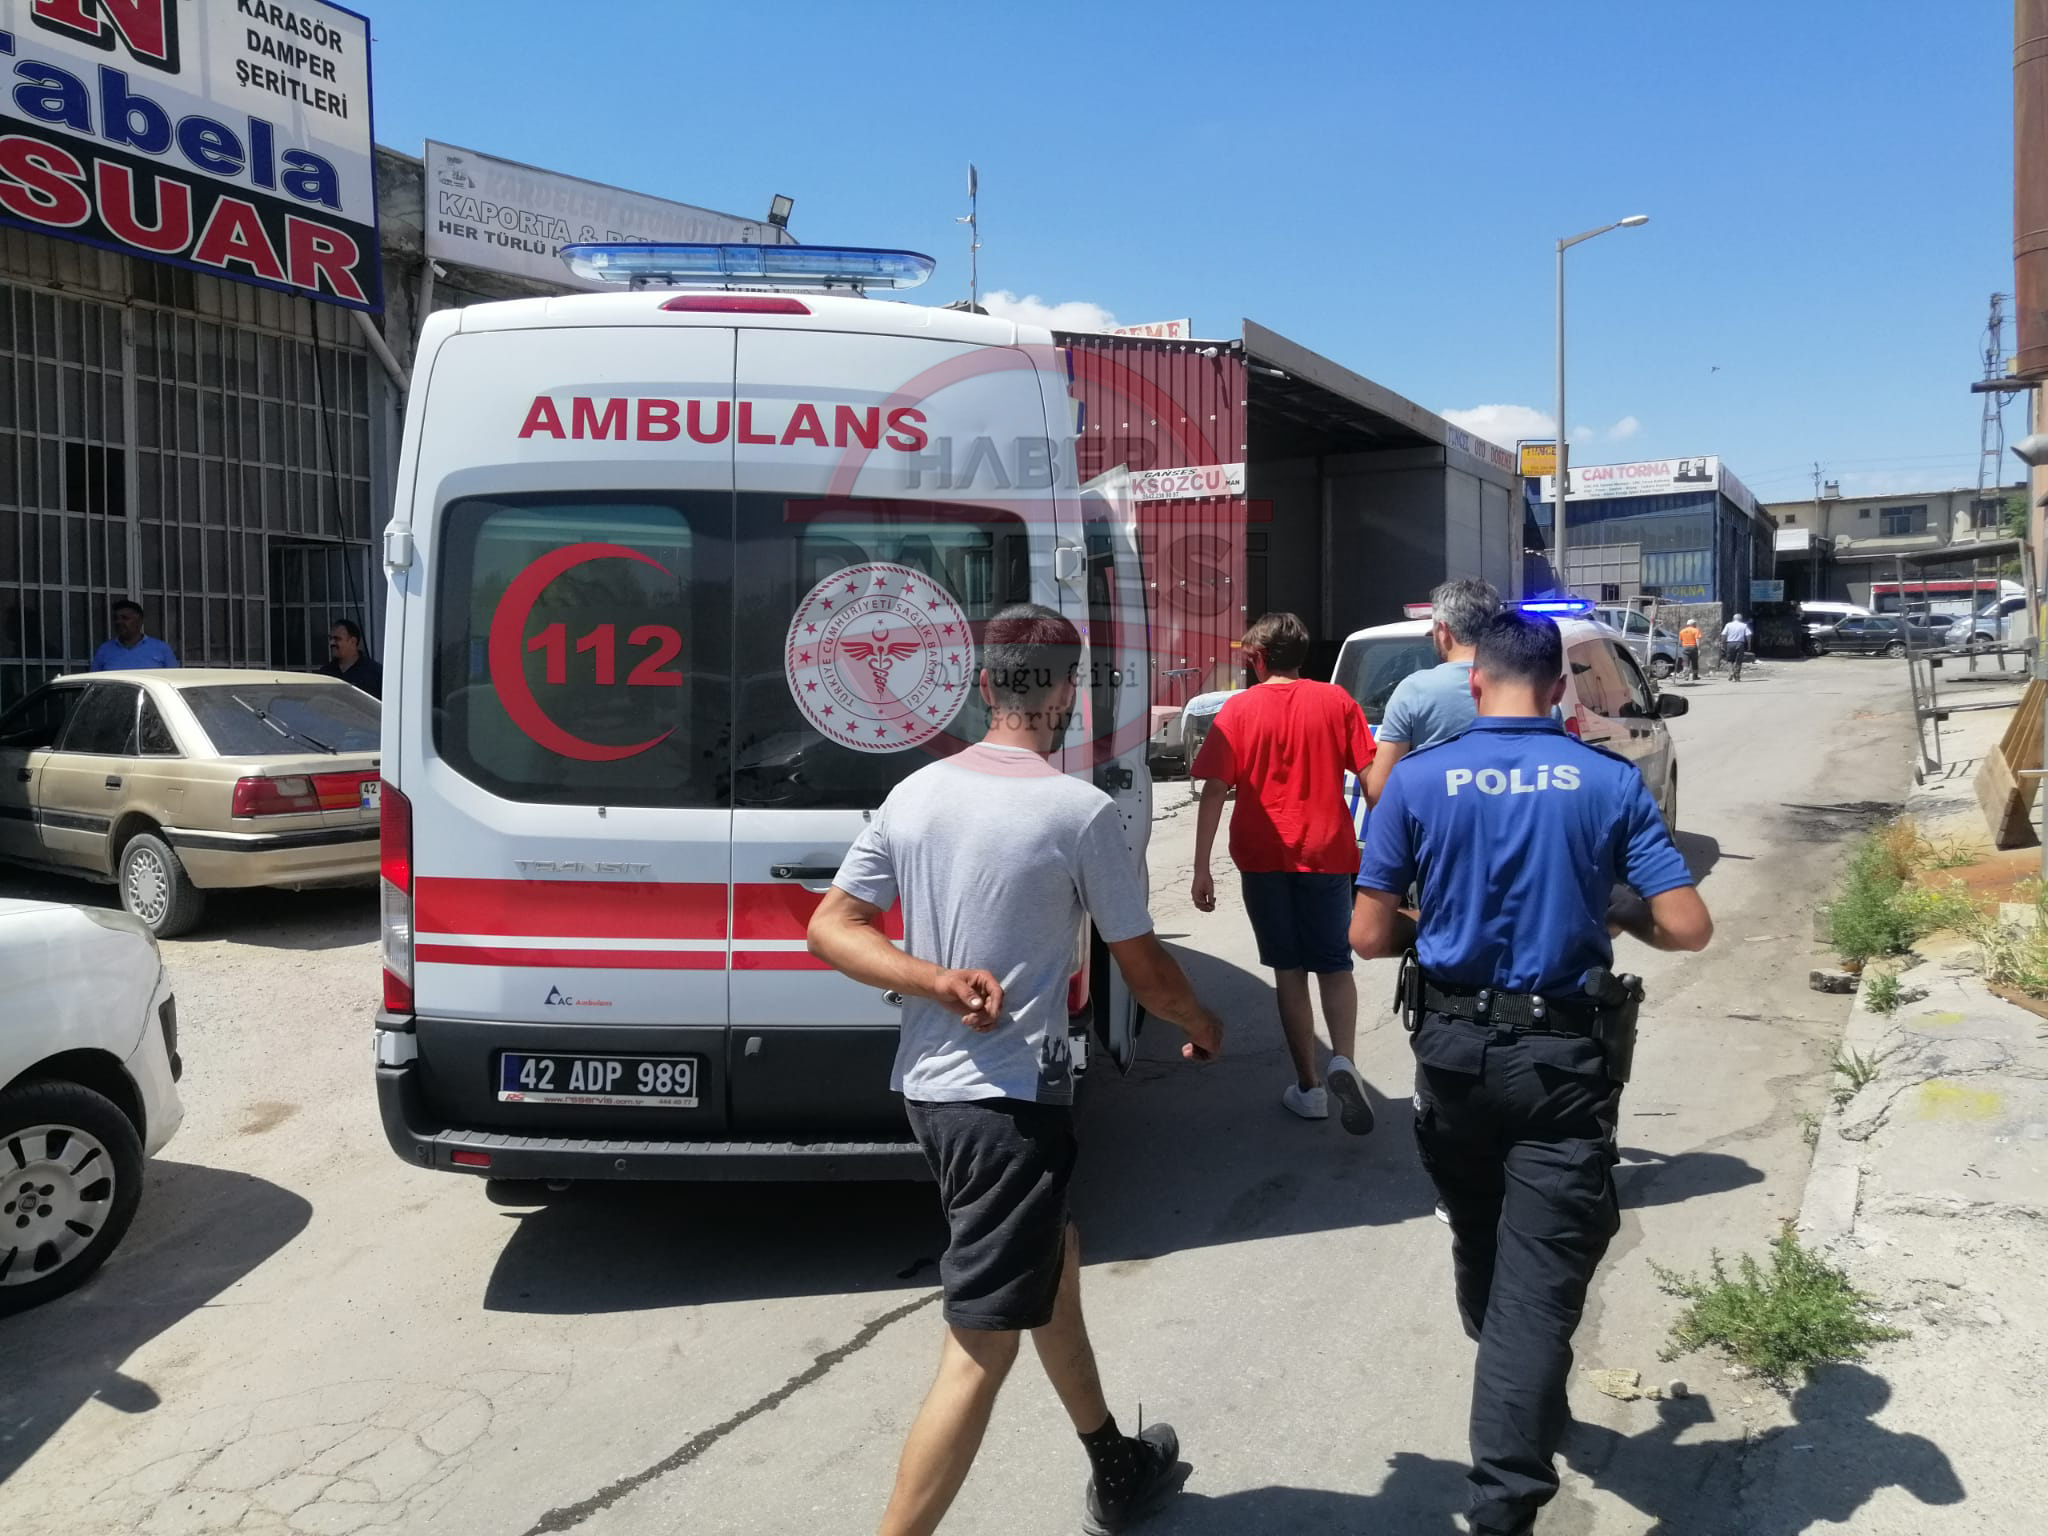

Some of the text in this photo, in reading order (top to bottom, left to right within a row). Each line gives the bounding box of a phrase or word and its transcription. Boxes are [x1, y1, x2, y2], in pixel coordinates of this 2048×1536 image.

[237, 0, 343, 54] KARASÖR
[247, 28, 337, 83] DAMPER
[235, 58, 348, 119] ŞERİTLERİ
[0, 30, 343, 212] abela
[438, 220, 479, 241] HER
[484, 230, 546, 254] TÜRLÜ
[439, 190, 573, 243] KAPORTA
[518, 395, 928, 452] AMBULANS
[1582, 462, 1671, 481] CAN TORNA
[822, 599, 892, 653] CUMHURİYETİ
[895, 603, 932, 639] SAĞLIK
[526, 624, 683, 687] 112
[823, 658, 854, 708] TÜRKİYE
[364, 783, 377, 794] 42
[513, 859, 652, 874] TRANSIT
[520, 1058, 691, 1094] 42 ADP 989
